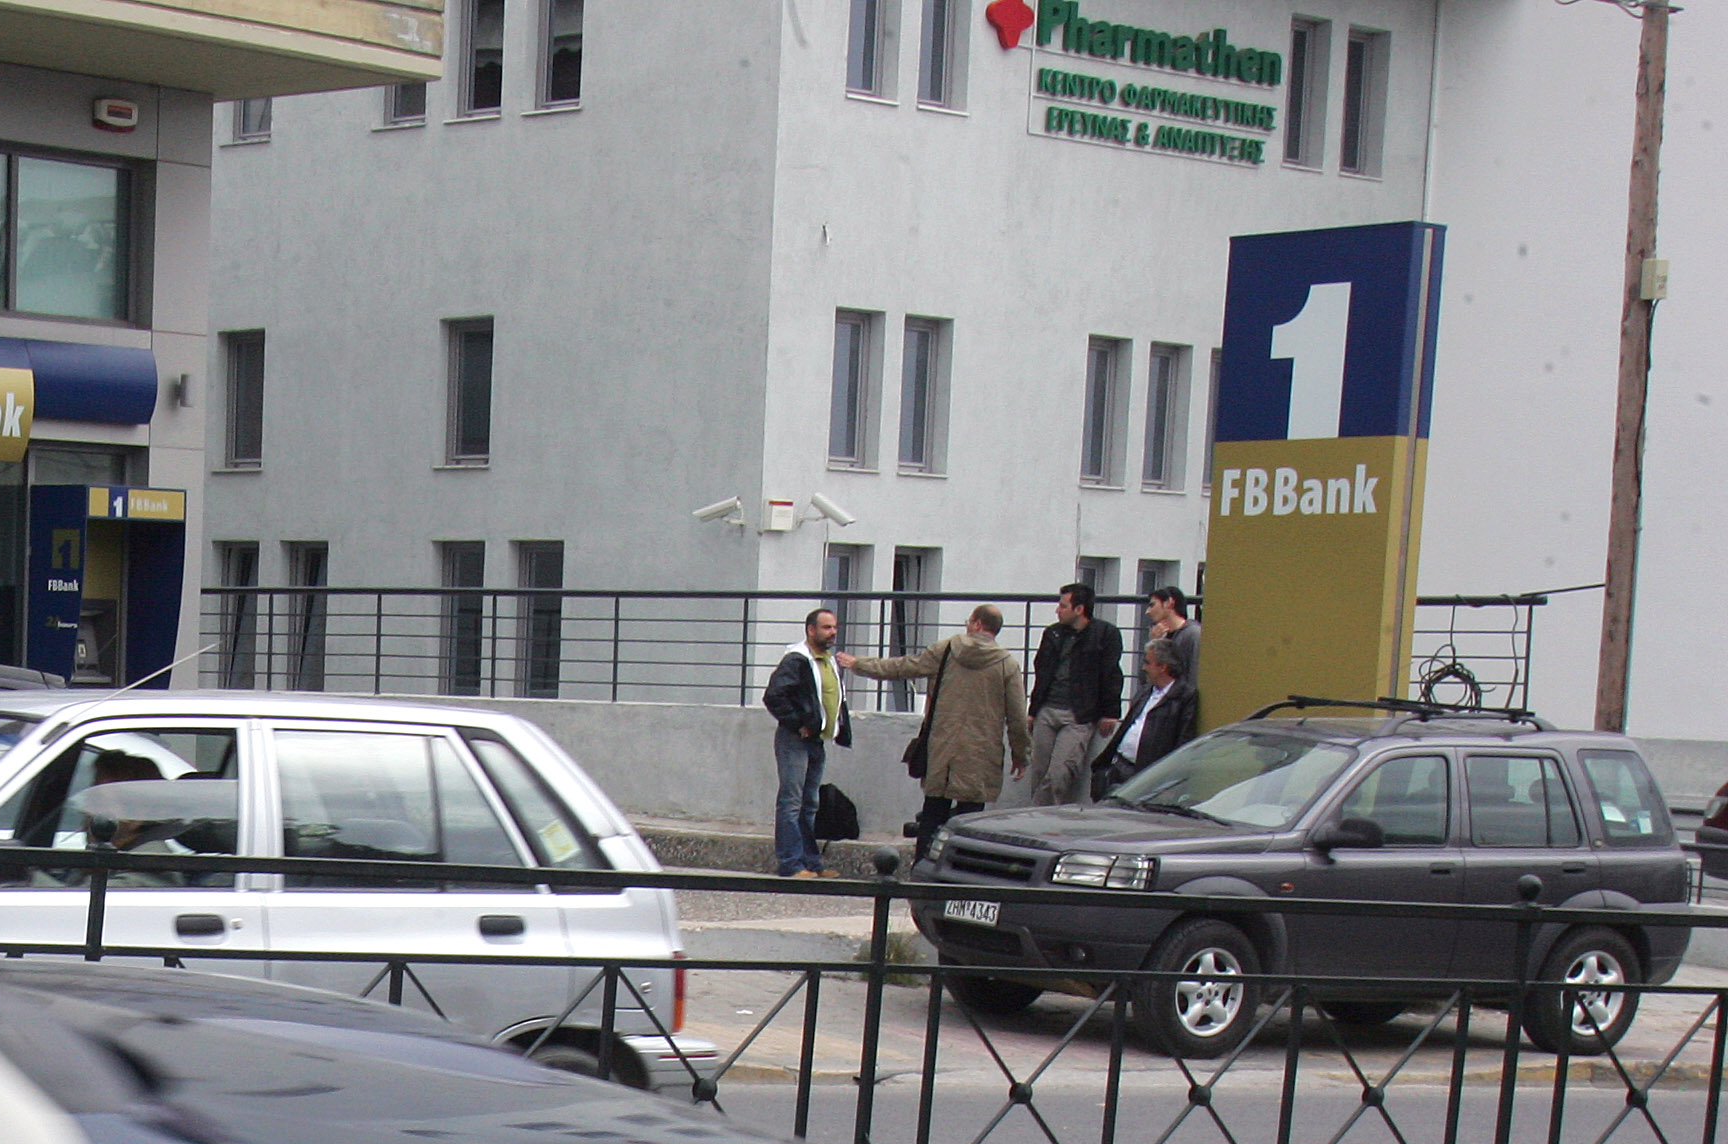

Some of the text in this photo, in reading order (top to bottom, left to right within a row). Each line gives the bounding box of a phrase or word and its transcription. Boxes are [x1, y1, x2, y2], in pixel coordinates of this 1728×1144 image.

[1036, 0, 1282, 86] Pharmathen
[1037, 67, 1277, 131] ΚΕΝΤΡΟ ΦΑΡΜΑΚΕΥΤΙΚΗΣ
[1045, 106, 1266, 164] ΕΡΕΥΝΑΣ & ΑΝΑΠΤΥΞΗΣ
[1269, 281, 1352, 441] 1
[113, 496, 169, 518] 1 FBBank
[1220, 463, 1379, 517] FBBank
[47, 579, 80, 592] FBBank
